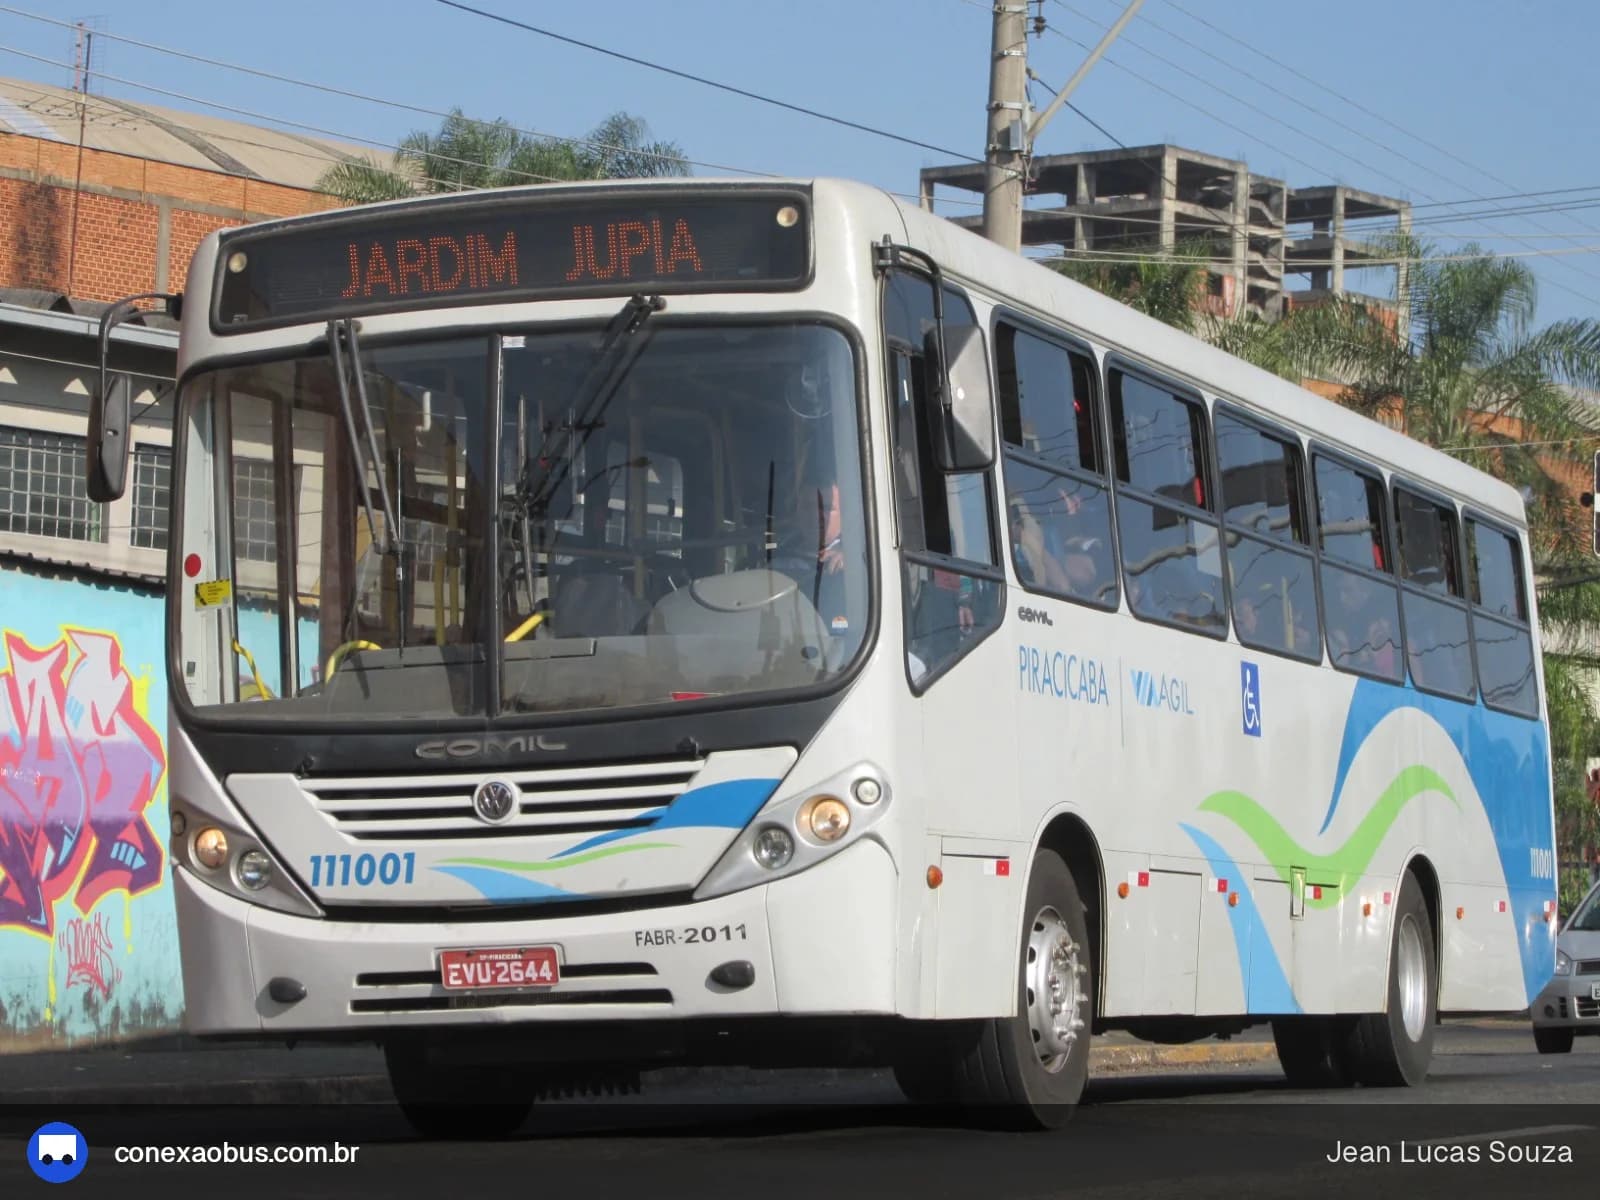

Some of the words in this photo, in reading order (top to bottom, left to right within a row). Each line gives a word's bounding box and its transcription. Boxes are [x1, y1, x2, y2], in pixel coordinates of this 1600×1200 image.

[341, 231, 519, 298] JARDIM
[565, 216, 704, 281] JUPIA
[1018, 644, 1109, 707] PIRACICABA
[414, 735, 568, 760] COMIL
[309, 851, 416, 887] 111001
[1530, 847, 1552, 879] 111001
